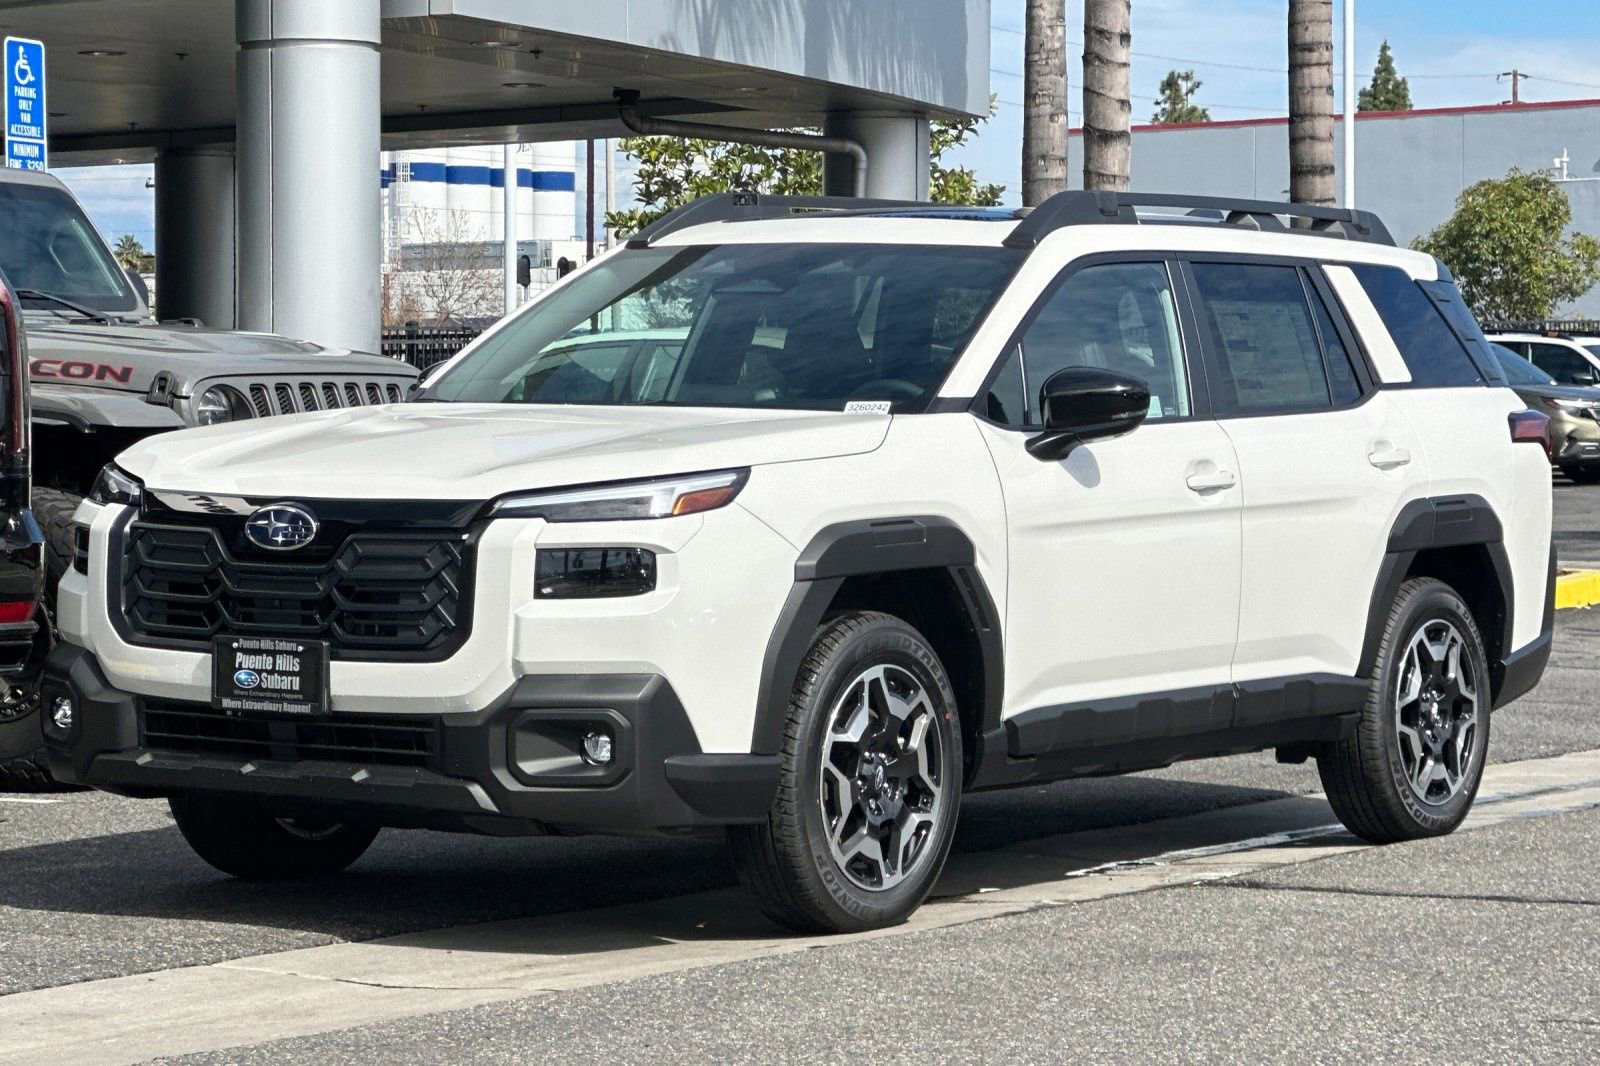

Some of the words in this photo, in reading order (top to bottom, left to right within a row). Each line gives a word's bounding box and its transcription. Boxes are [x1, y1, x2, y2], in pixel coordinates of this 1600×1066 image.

[14, 85, 37, 99] PARKING
[18, 99, 32, 111] ONLY
[20, 112, 31, 124] VAN
[10, 123, 41, 138] ACCESSIBLE
[13, 142, 39, 158] MINIMUM
[9, 158, 22, 169] FINE
[30, 358, 134, 383] CON
[847, 403, 888, 412] 3260242
[239, 639, 260, 649] Puente
[261, 640, 275, 650] Hills
[275, 640, 297, 651] Subaru
[235, 652, 273, 670] Puente
[275, 653, 300, 672] Hills
[261, 672, 300, 691] Subaru
[221, 699, 242, 709] Where
[242, 699, 282, 712] Extraordinary
[282, 702, 311, 713] Happens!
